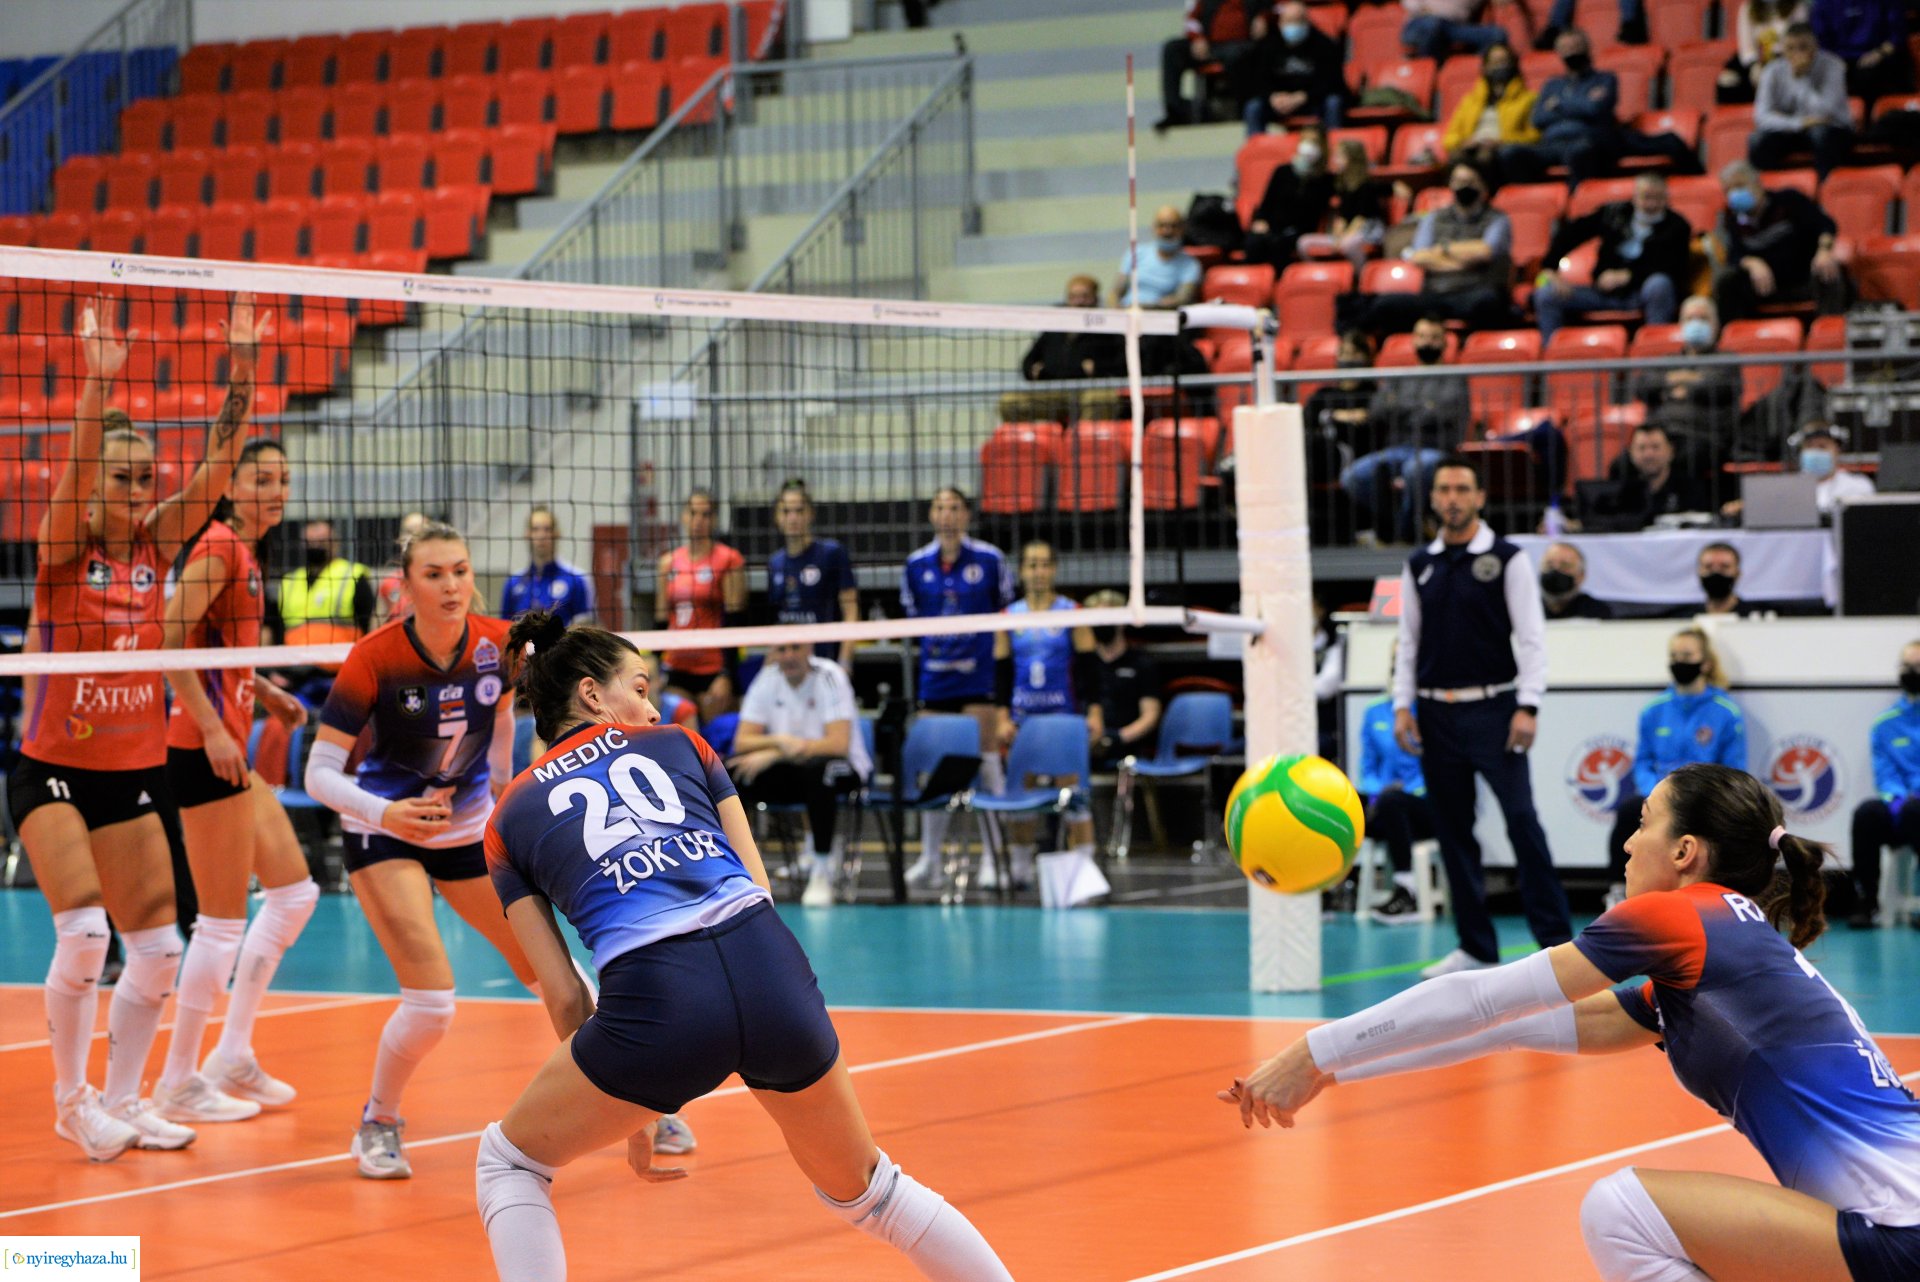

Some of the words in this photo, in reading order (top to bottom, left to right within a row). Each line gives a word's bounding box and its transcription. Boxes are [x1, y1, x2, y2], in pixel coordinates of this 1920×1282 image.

[438, 719, 469, 781] 7
[532, 728, 629, 783] MEDIĆ
[46, 777, 71, 800] 11
[548, 753, 686, 862] 20
[600, 838, 680, 895] ŽOK
